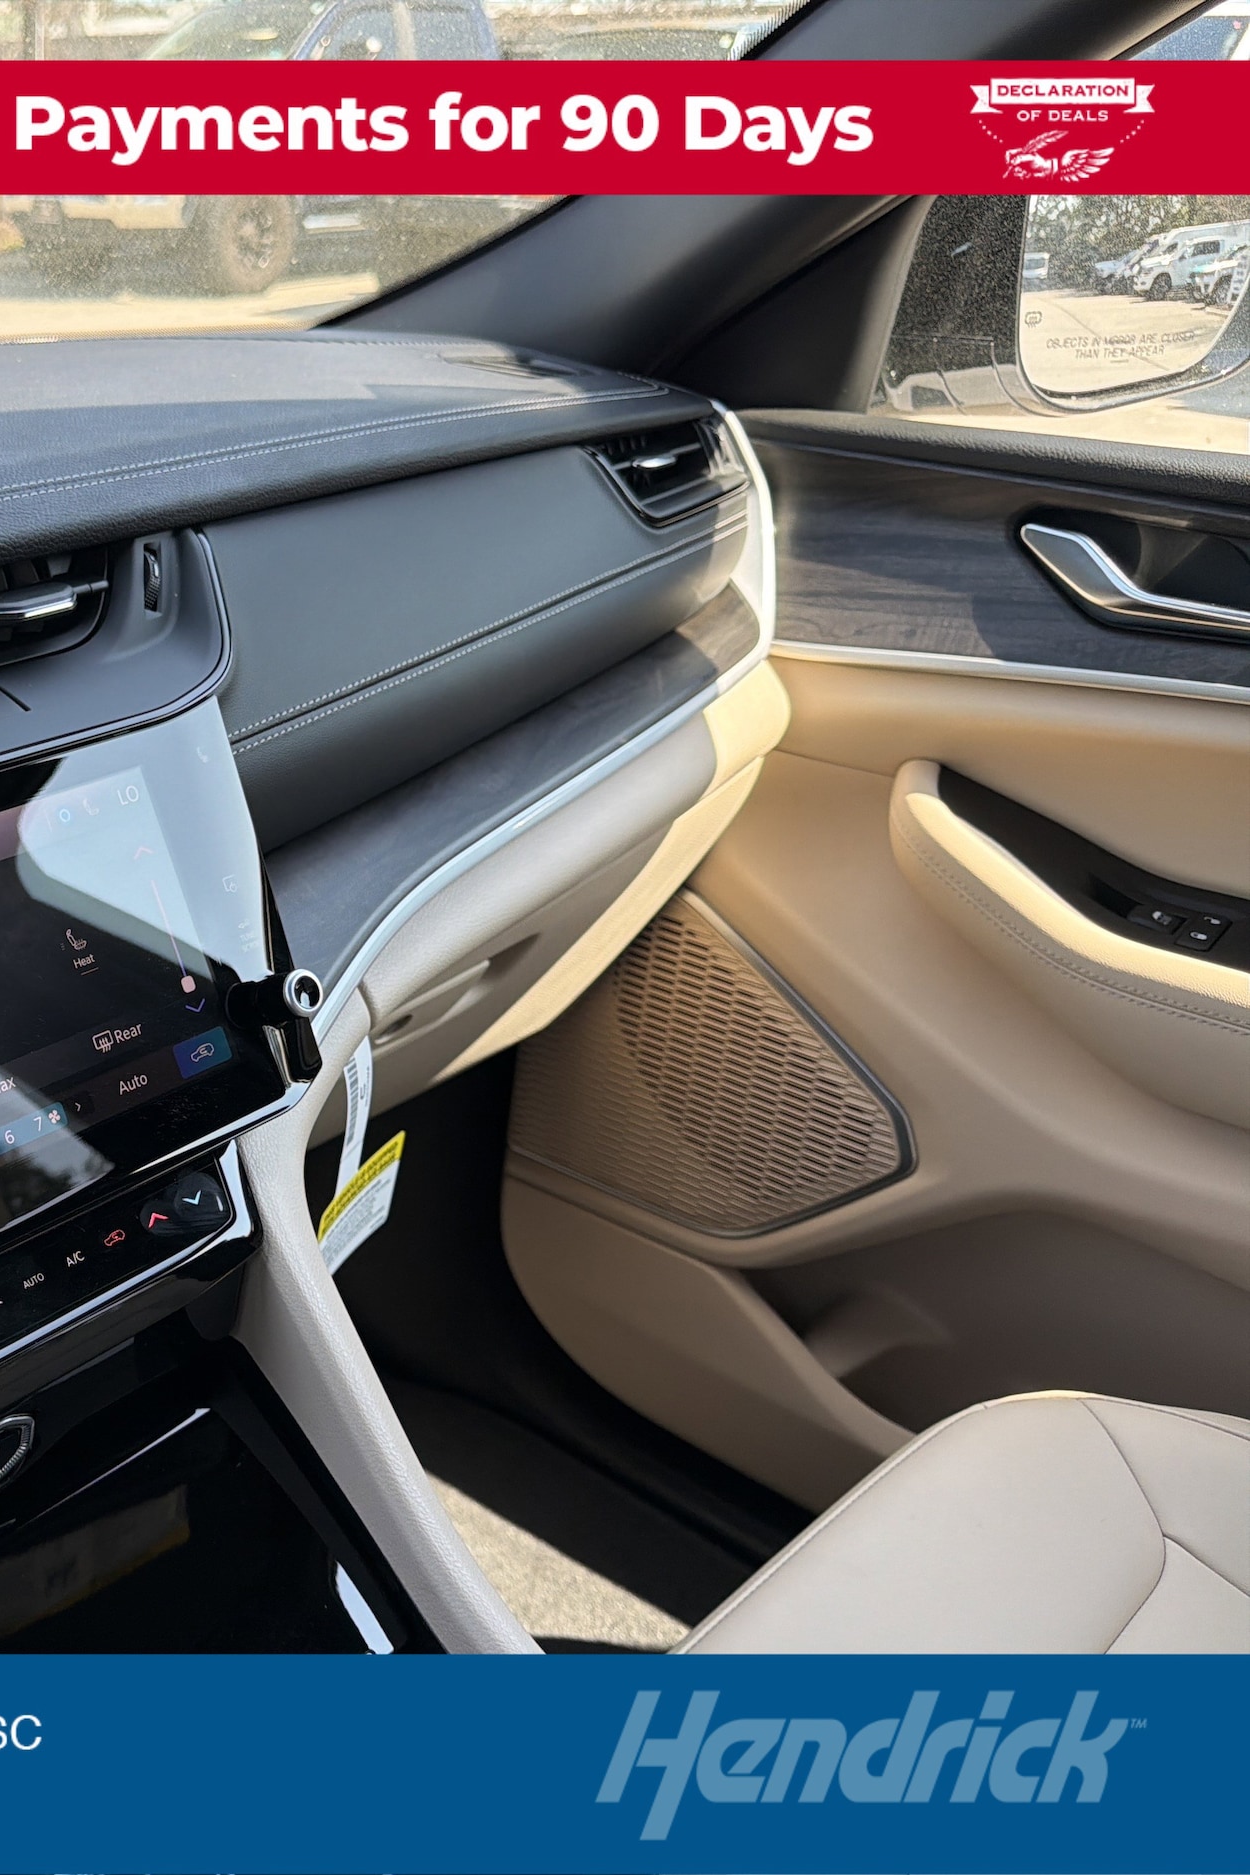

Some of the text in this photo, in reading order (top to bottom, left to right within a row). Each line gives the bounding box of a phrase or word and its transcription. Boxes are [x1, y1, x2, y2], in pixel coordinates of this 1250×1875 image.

[1046, 336, 1088, 350] OBJECTS
[116, 785, 139, 805] LO
[72, 952, 96, 971] Heat
[114, 1023, 143, 1044] Rear
[118, 1072, 148, 1096] Auto
[4, 1129, 16, 1145] 6
[33, 1116, 44, 1132] 7
[66, 1250, 86, 1268] A/C
[22, 1272, 46, 1290] AUTO
